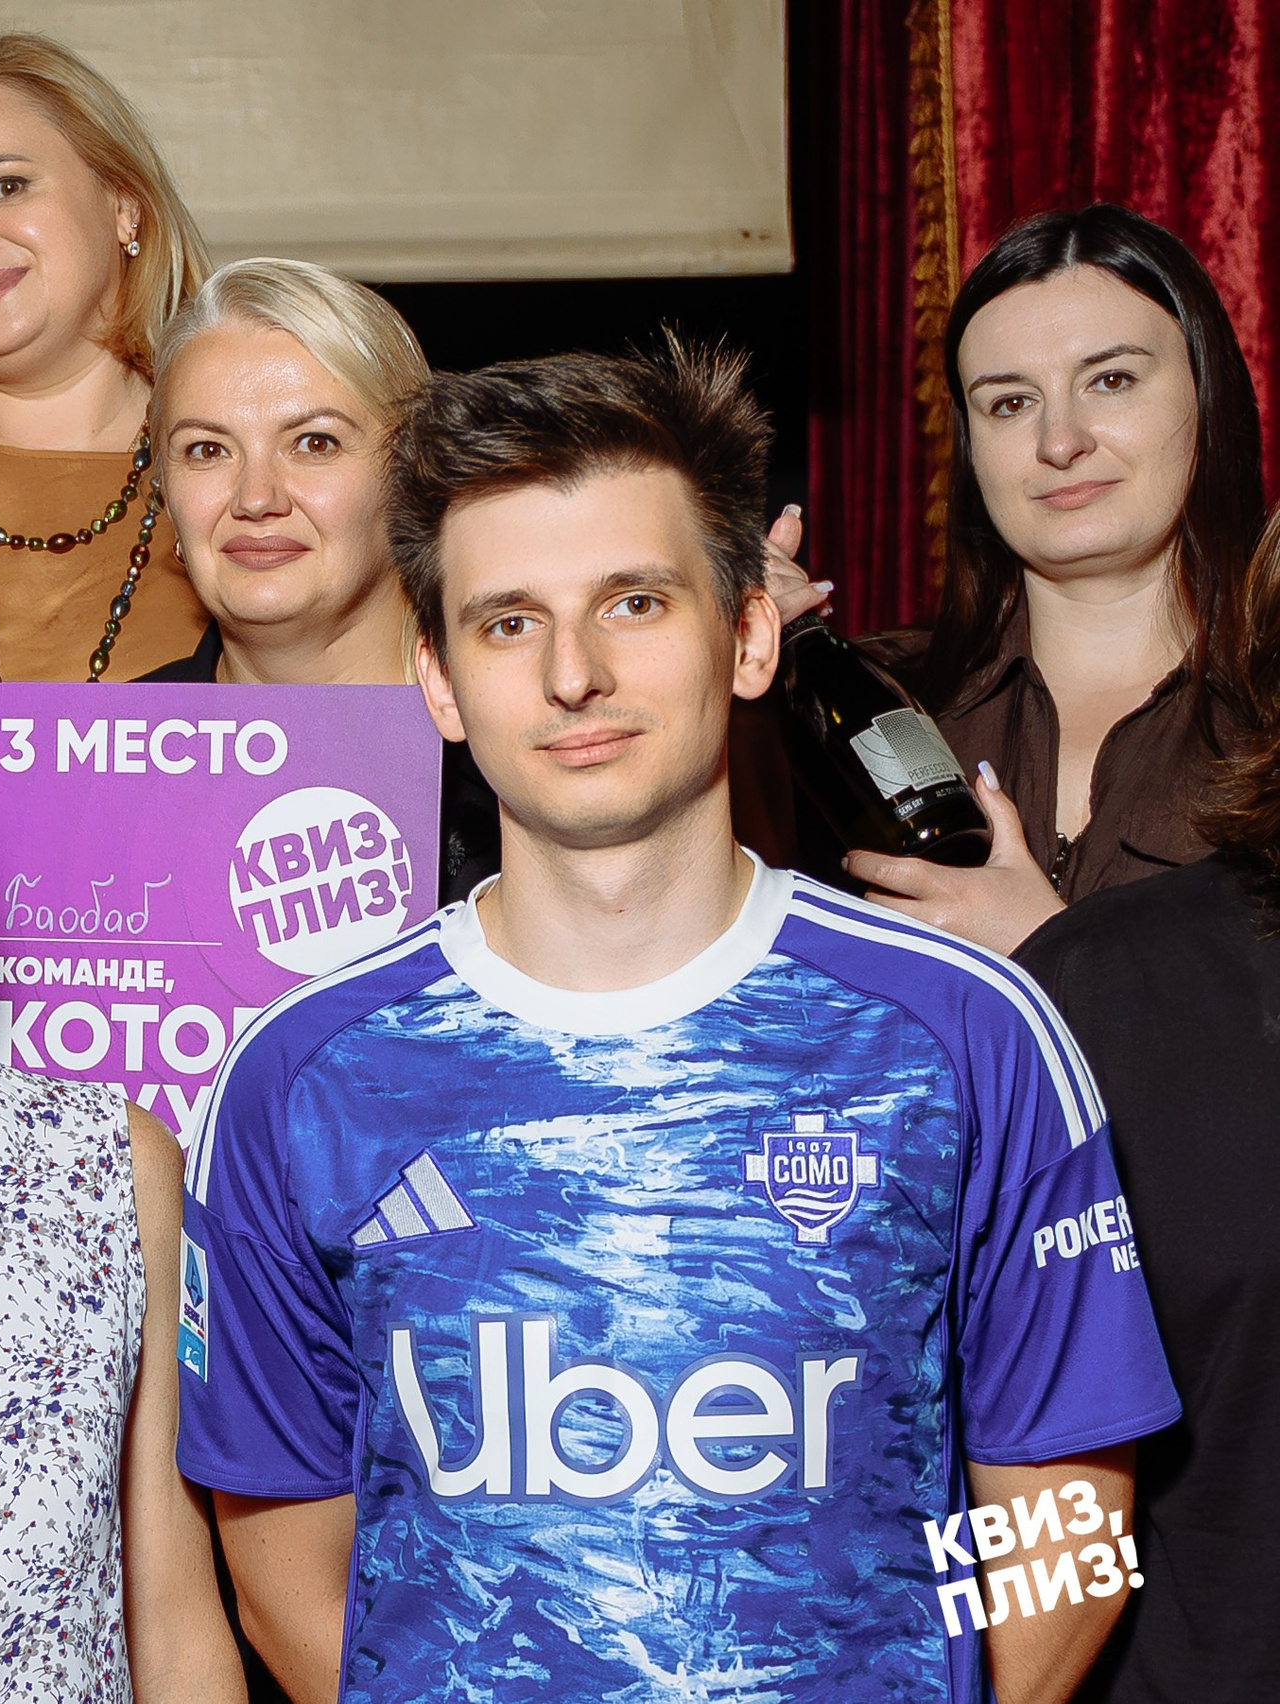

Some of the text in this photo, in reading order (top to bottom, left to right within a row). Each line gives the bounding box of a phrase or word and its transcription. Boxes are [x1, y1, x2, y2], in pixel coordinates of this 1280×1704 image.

[0, 718, 288, 775] 3 МЕСТО
[231, 811, 404, 894] КВИЗ,
[5, 873, 172, 935] Баобаб
[237, 861, 414, 950] ПЛИЗ!
[773, 1154, 849, 1185] COMO
[788, 1140, 832, 1153] 1907
[1110, 1241, 1140, 1273] NE
[391, 1320, 860, 1499] Uber
